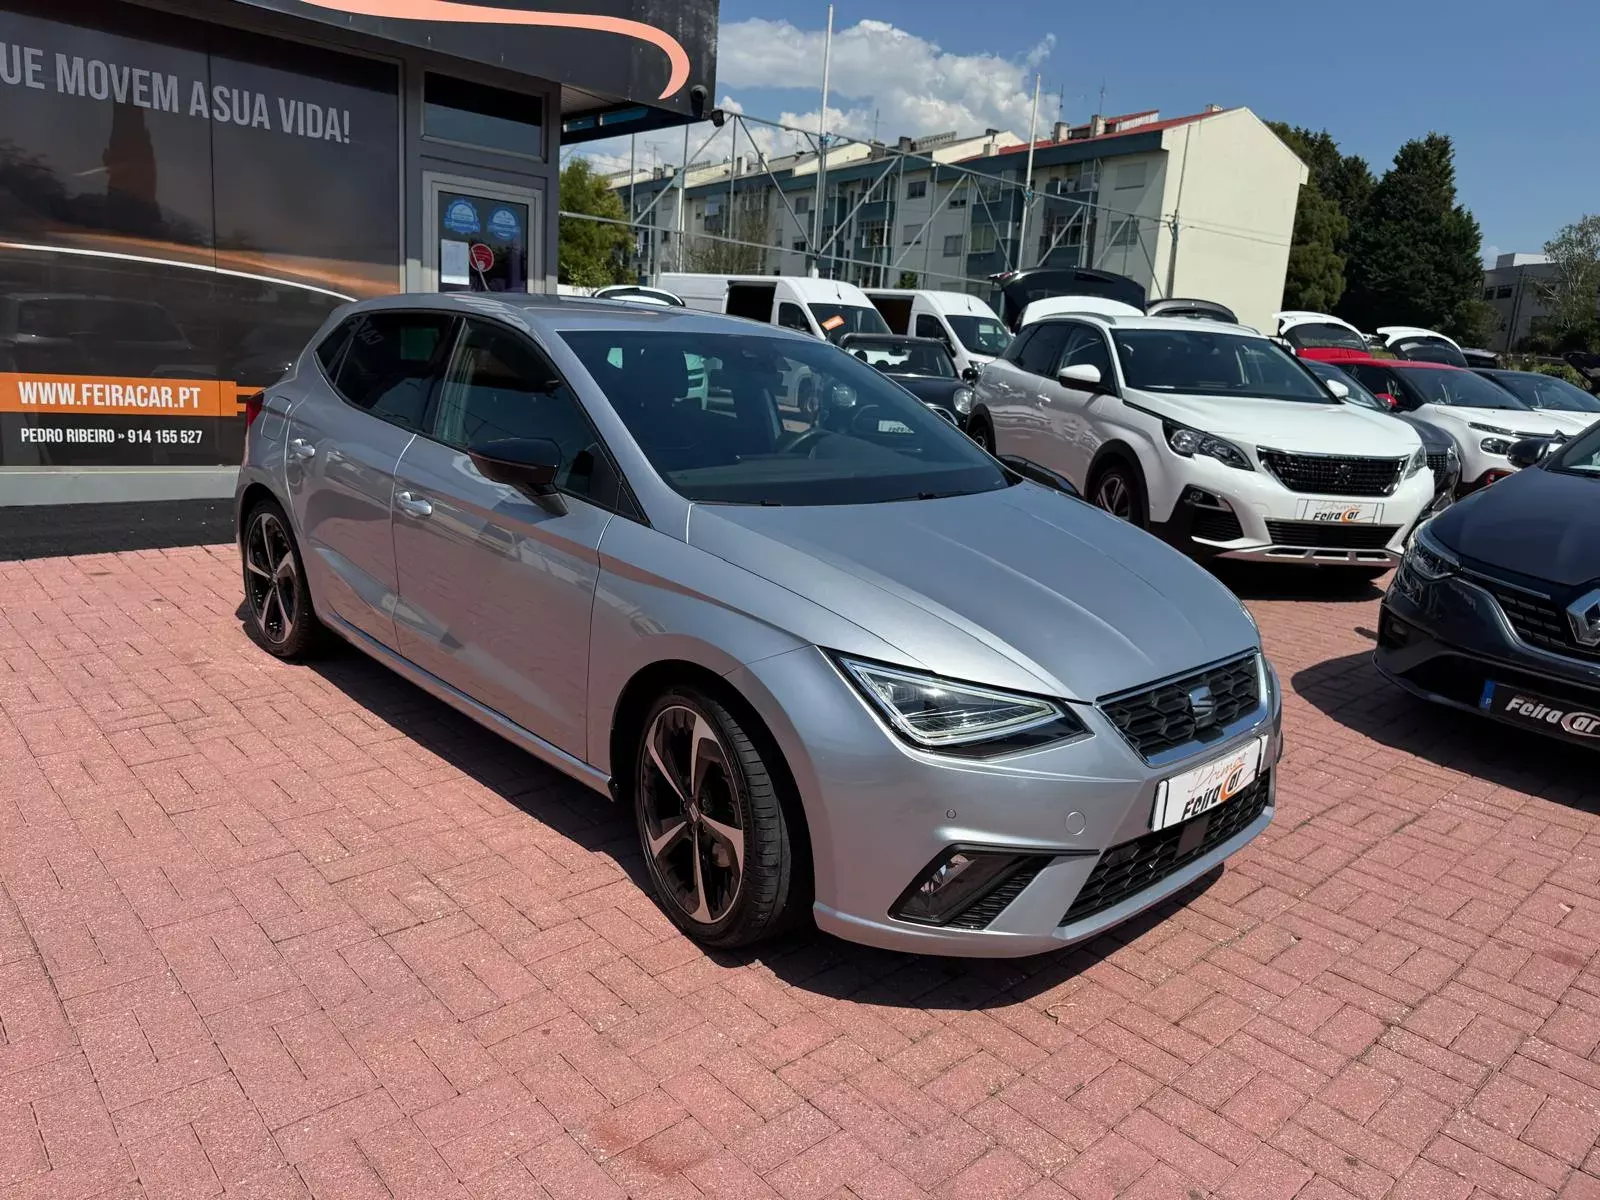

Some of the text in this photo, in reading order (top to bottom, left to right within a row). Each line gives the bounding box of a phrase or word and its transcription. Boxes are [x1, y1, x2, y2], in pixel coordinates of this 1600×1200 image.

[55, 53, 180, 114] MOVEM
[278, 97, 350, 144] VIDA!
[18, 382, 200, 408] WWW.FEIRACAR.PT
[20, 427, 63, 443] PEDRO
[66, 428, 115, 444] RIBEIRO
[127, 429, 152, 444] 914
[155, 429, 179, 444] 155
[180, 430, 203, 444] 527
